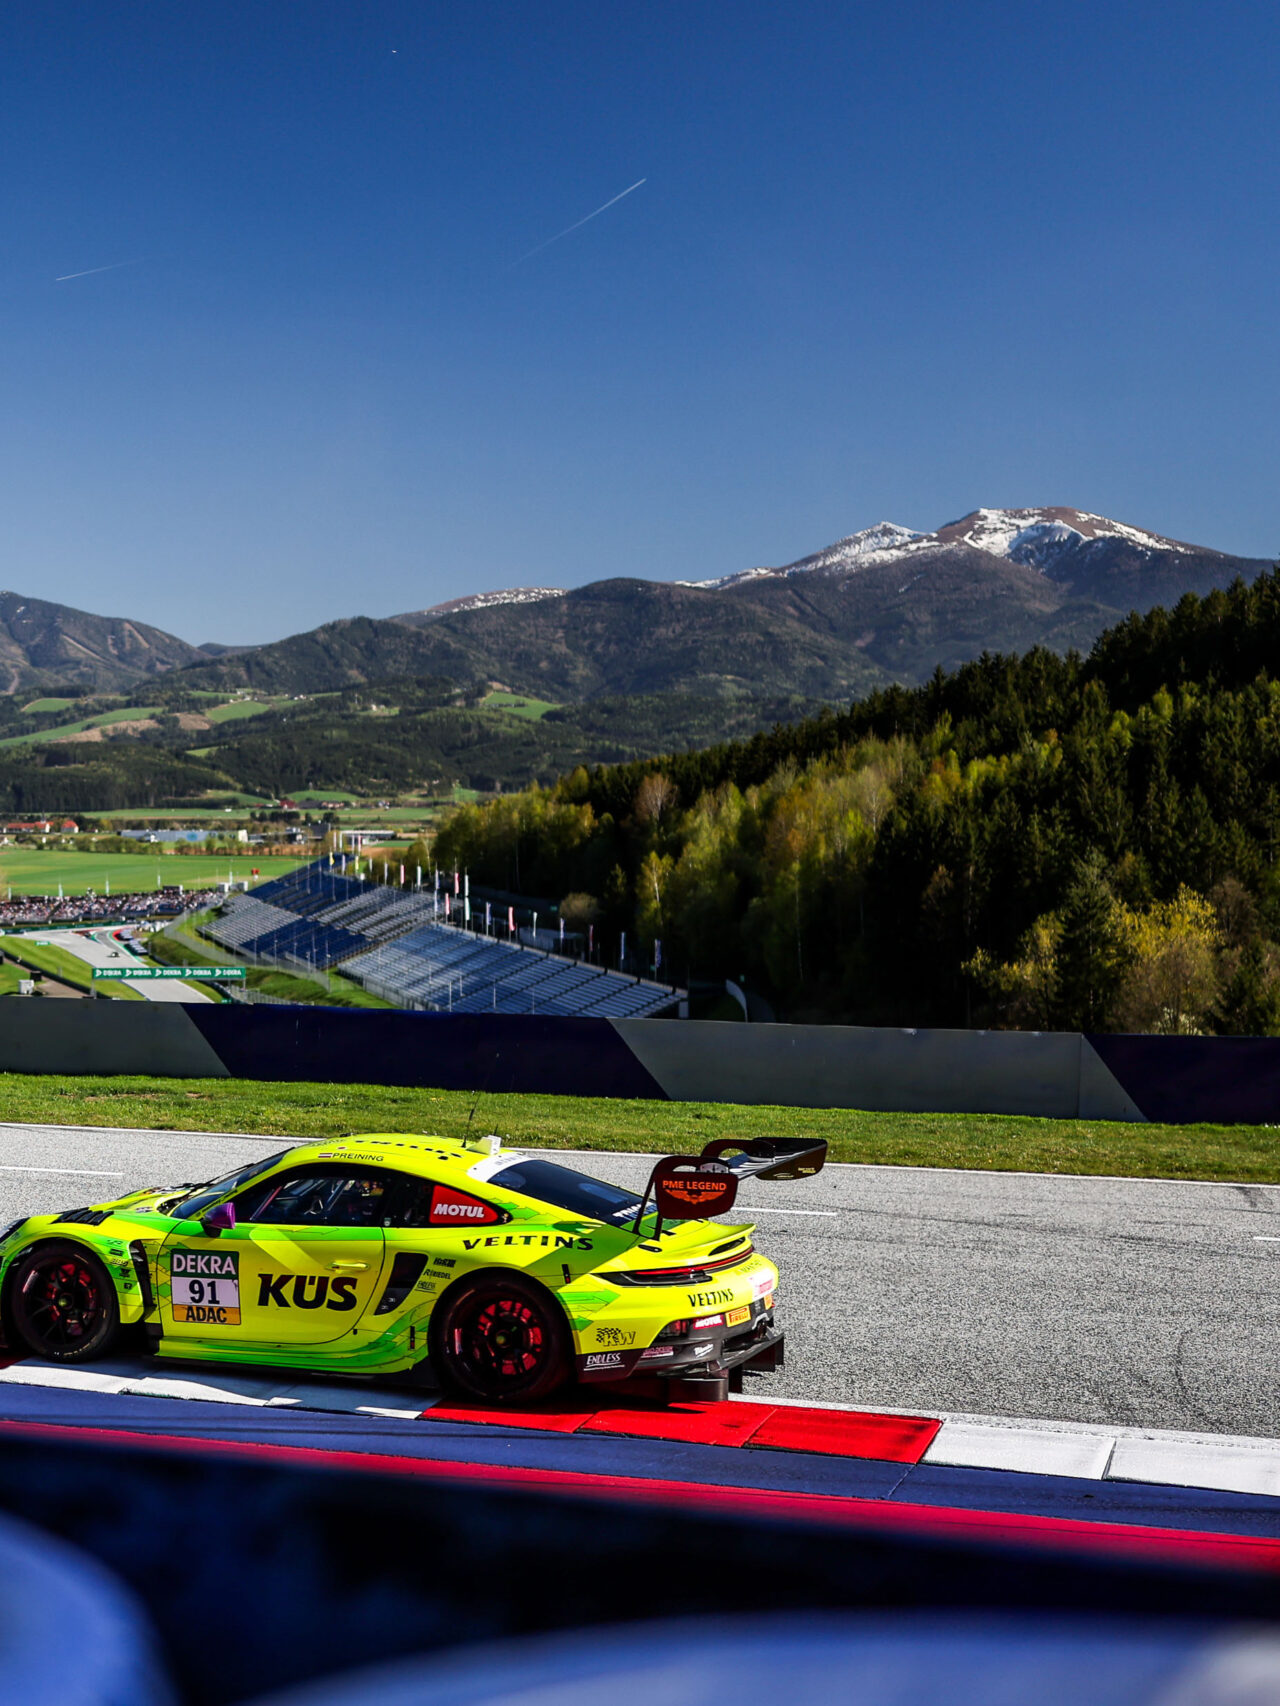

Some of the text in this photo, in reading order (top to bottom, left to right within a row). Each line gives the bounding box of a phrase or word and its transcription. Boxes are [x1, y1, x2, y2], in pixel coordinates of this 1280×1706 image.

[333, 1152, 384, 1162] PREINING
[662, 1180, 727, 1191] PME LEGEND
[433, 1203, 485, 1218] MOTUL
[462, 1235, 594, 1251] VELTINS
[173, 1253, 236, 1275] DEKRA
[189, 1279, 220, 1305] 91
[257, 1273, 358, 1312] KÜS
[687, 1288, 734, 1307] VELTINS
[185, 1306, 227, 1323] ADAC
[586, 1352, 621, 1365] ENDLESS
